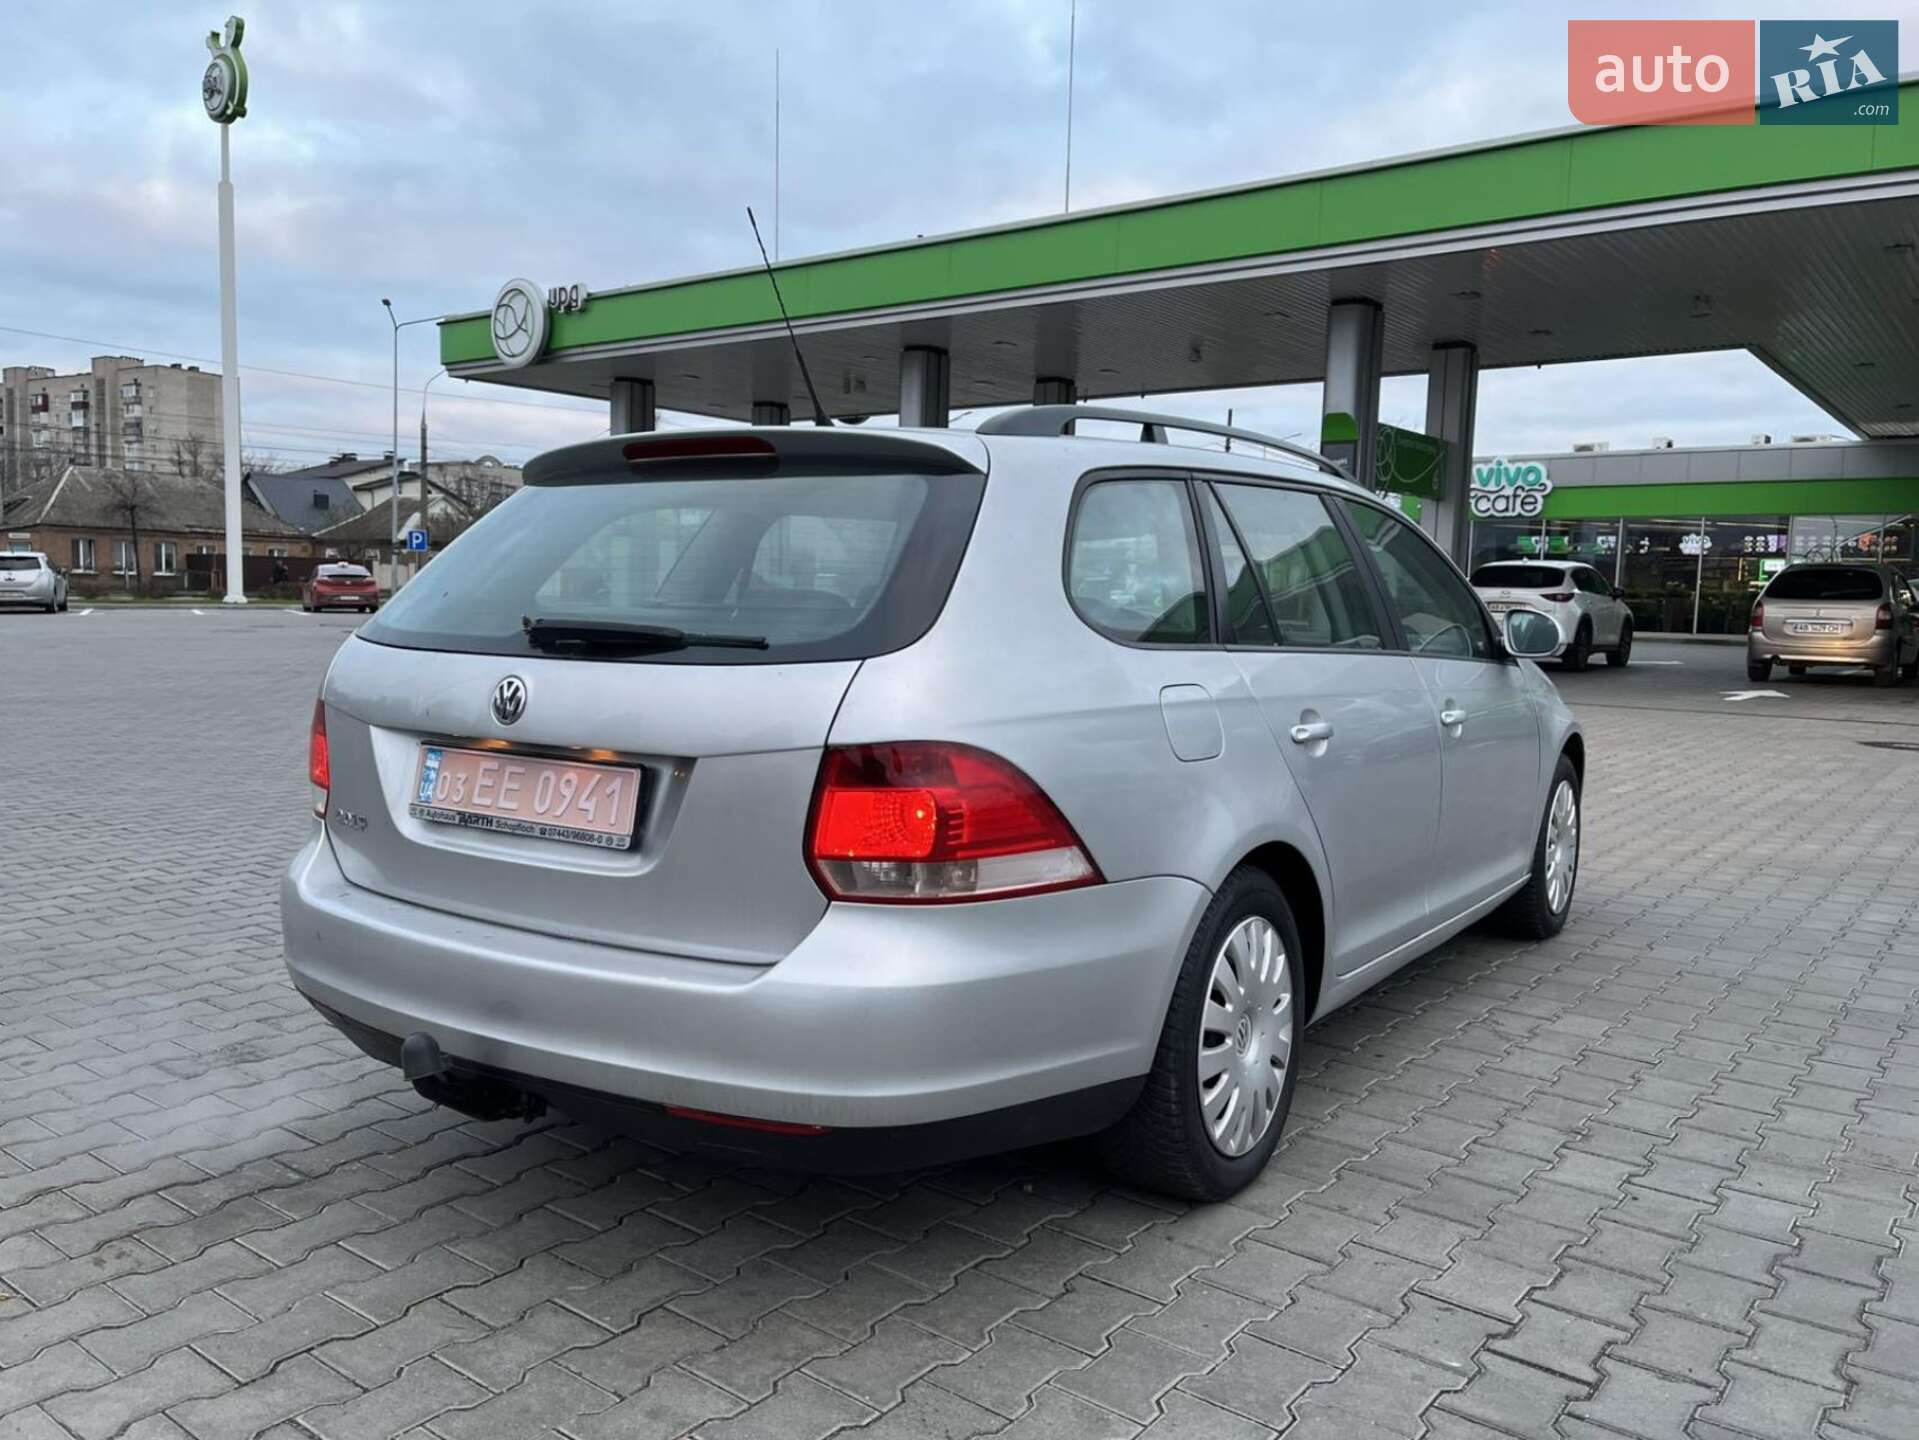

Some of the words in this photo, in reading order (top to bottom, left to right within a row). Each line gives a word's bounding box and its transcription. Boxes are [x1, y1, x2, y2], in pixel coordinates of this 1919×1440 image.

[548, 284, 580, 312] upg
[1475, 460, 1542, 487] vivo
[412, 532, 423, 549] P
[436, 771, 467, 803] 03
[471, 760, 525, 811] EE
[533, 769, 624, 827] 0941
